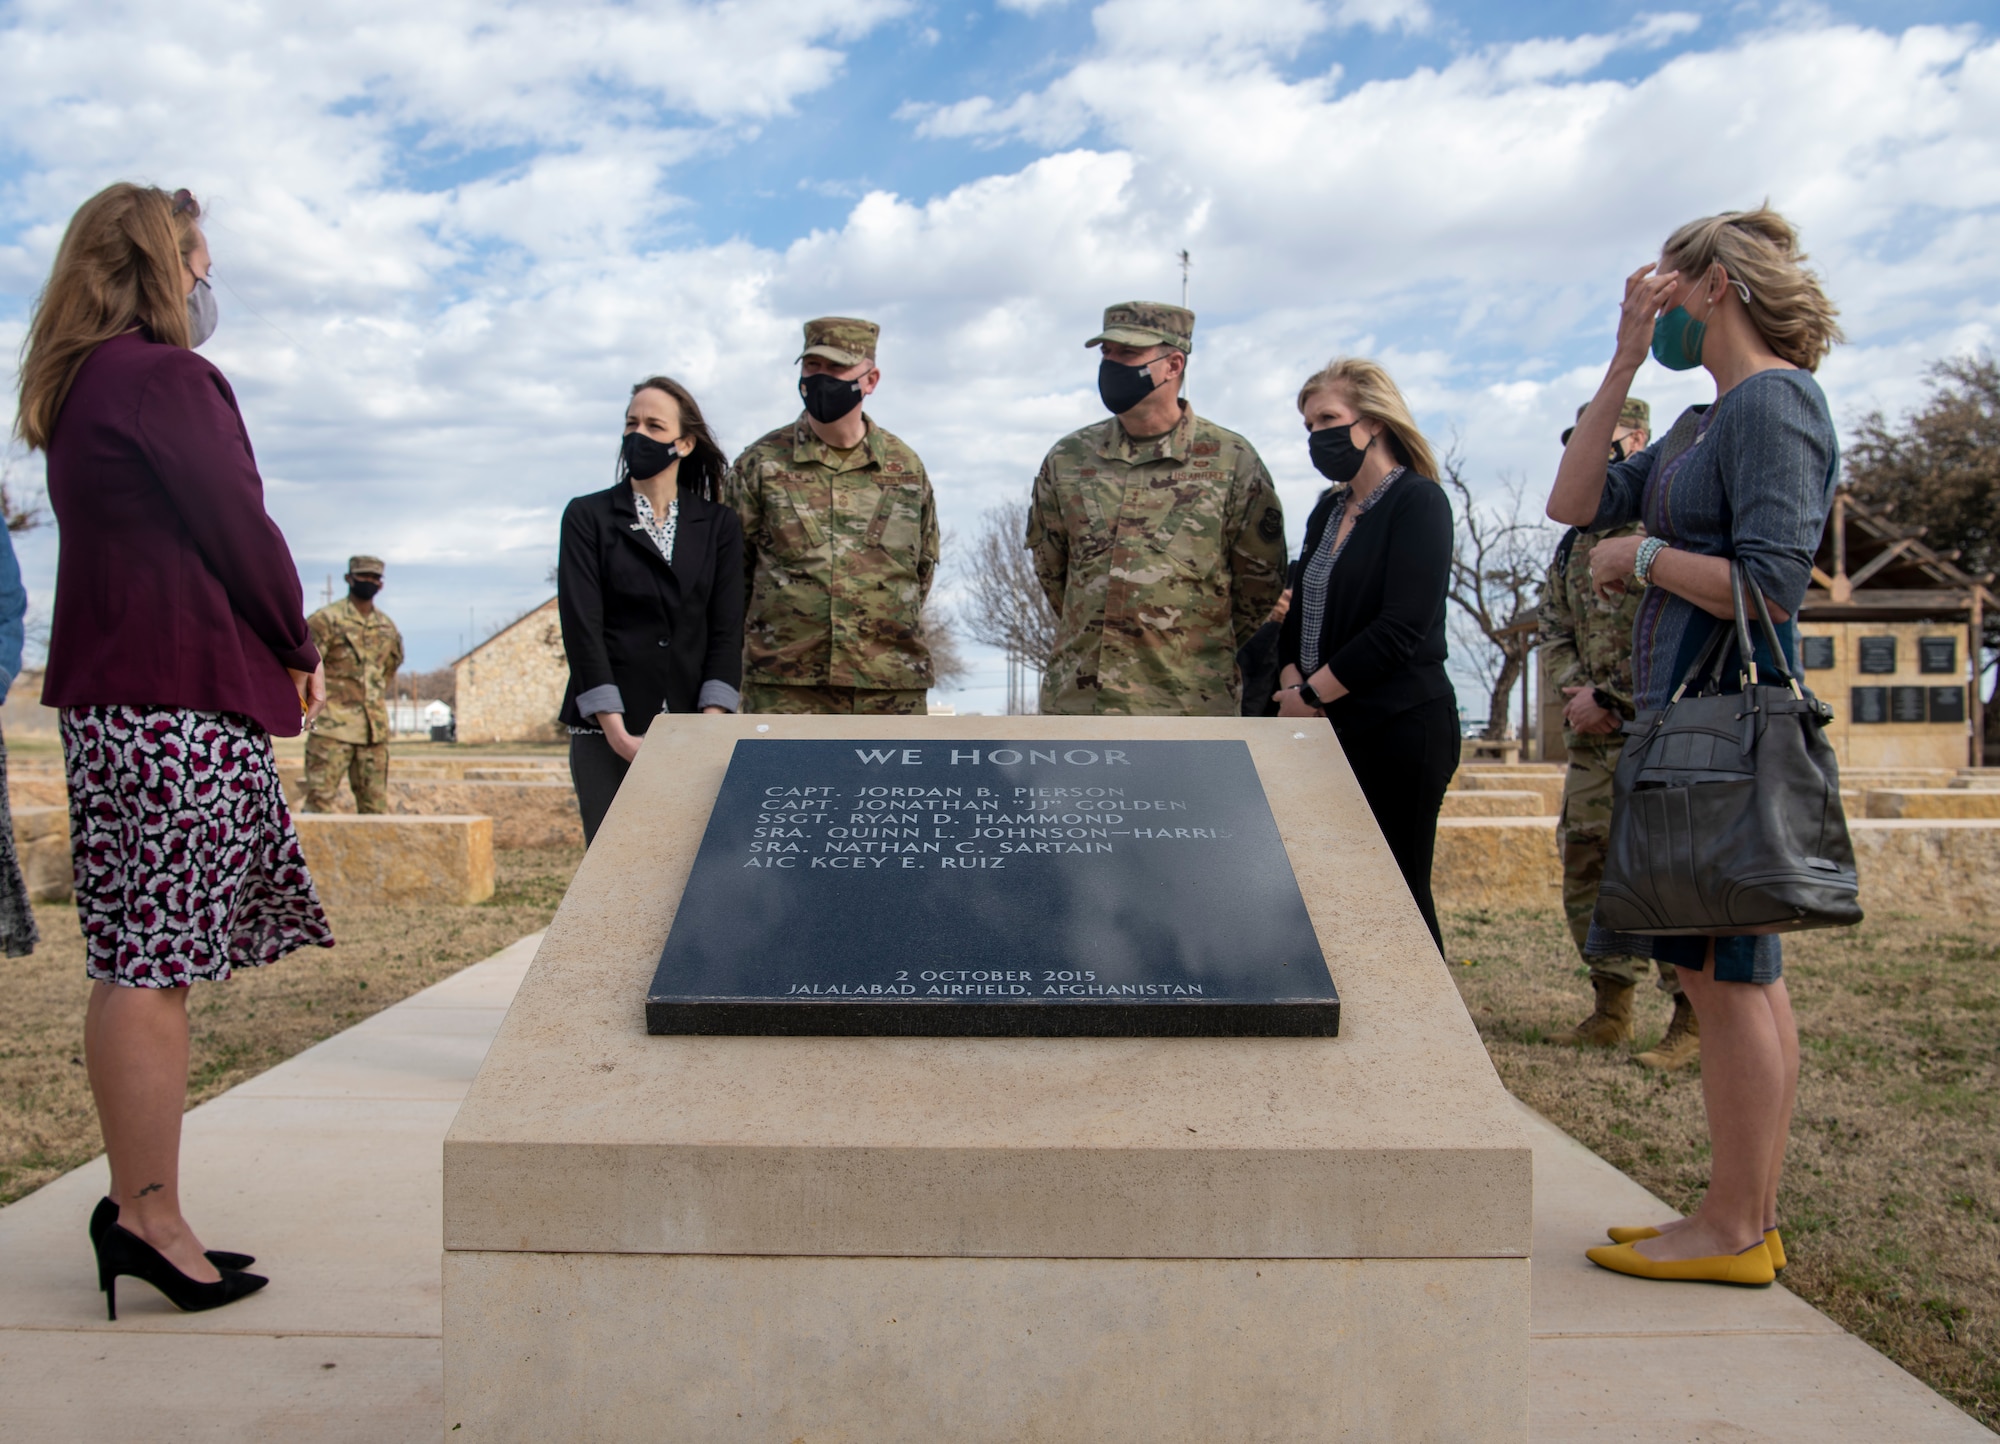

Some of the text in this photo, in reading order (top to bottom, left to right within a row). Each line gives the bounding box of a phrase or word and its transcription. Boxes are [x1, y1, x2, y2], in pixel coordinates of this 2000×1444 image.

[855, 749, 1132, 766] WE HONOR
[765, 786, 1125, 798] CAPT. JORDAN B. PIERSON
[761, 800, 839, 810] CAPT.
[853, 800, 999, 811] JONATHAN
[1074, 800, 1188, 811] GOLDEN
[757, 813, 1124, 824] SSGT. RYAN D. HAMMOND
[753, 827, 812, 838] SRA.
[827, 827, 920, 838] QUINN
[934, 828, 955, 838] L.
[749, 842, 1113, 853] SRA. NATHAN C. SARTAIN
[811, 857, 888, 868] KCEY
[901, 857, 925, 868] E.
[941, 857, 1006, 868] RUIZ
[895, 970, 1096, 981] 2 OCTOBER 2015
[784, 984, 1204, 996] JALALABAD AIRFIELD, AFGHANISTAN
